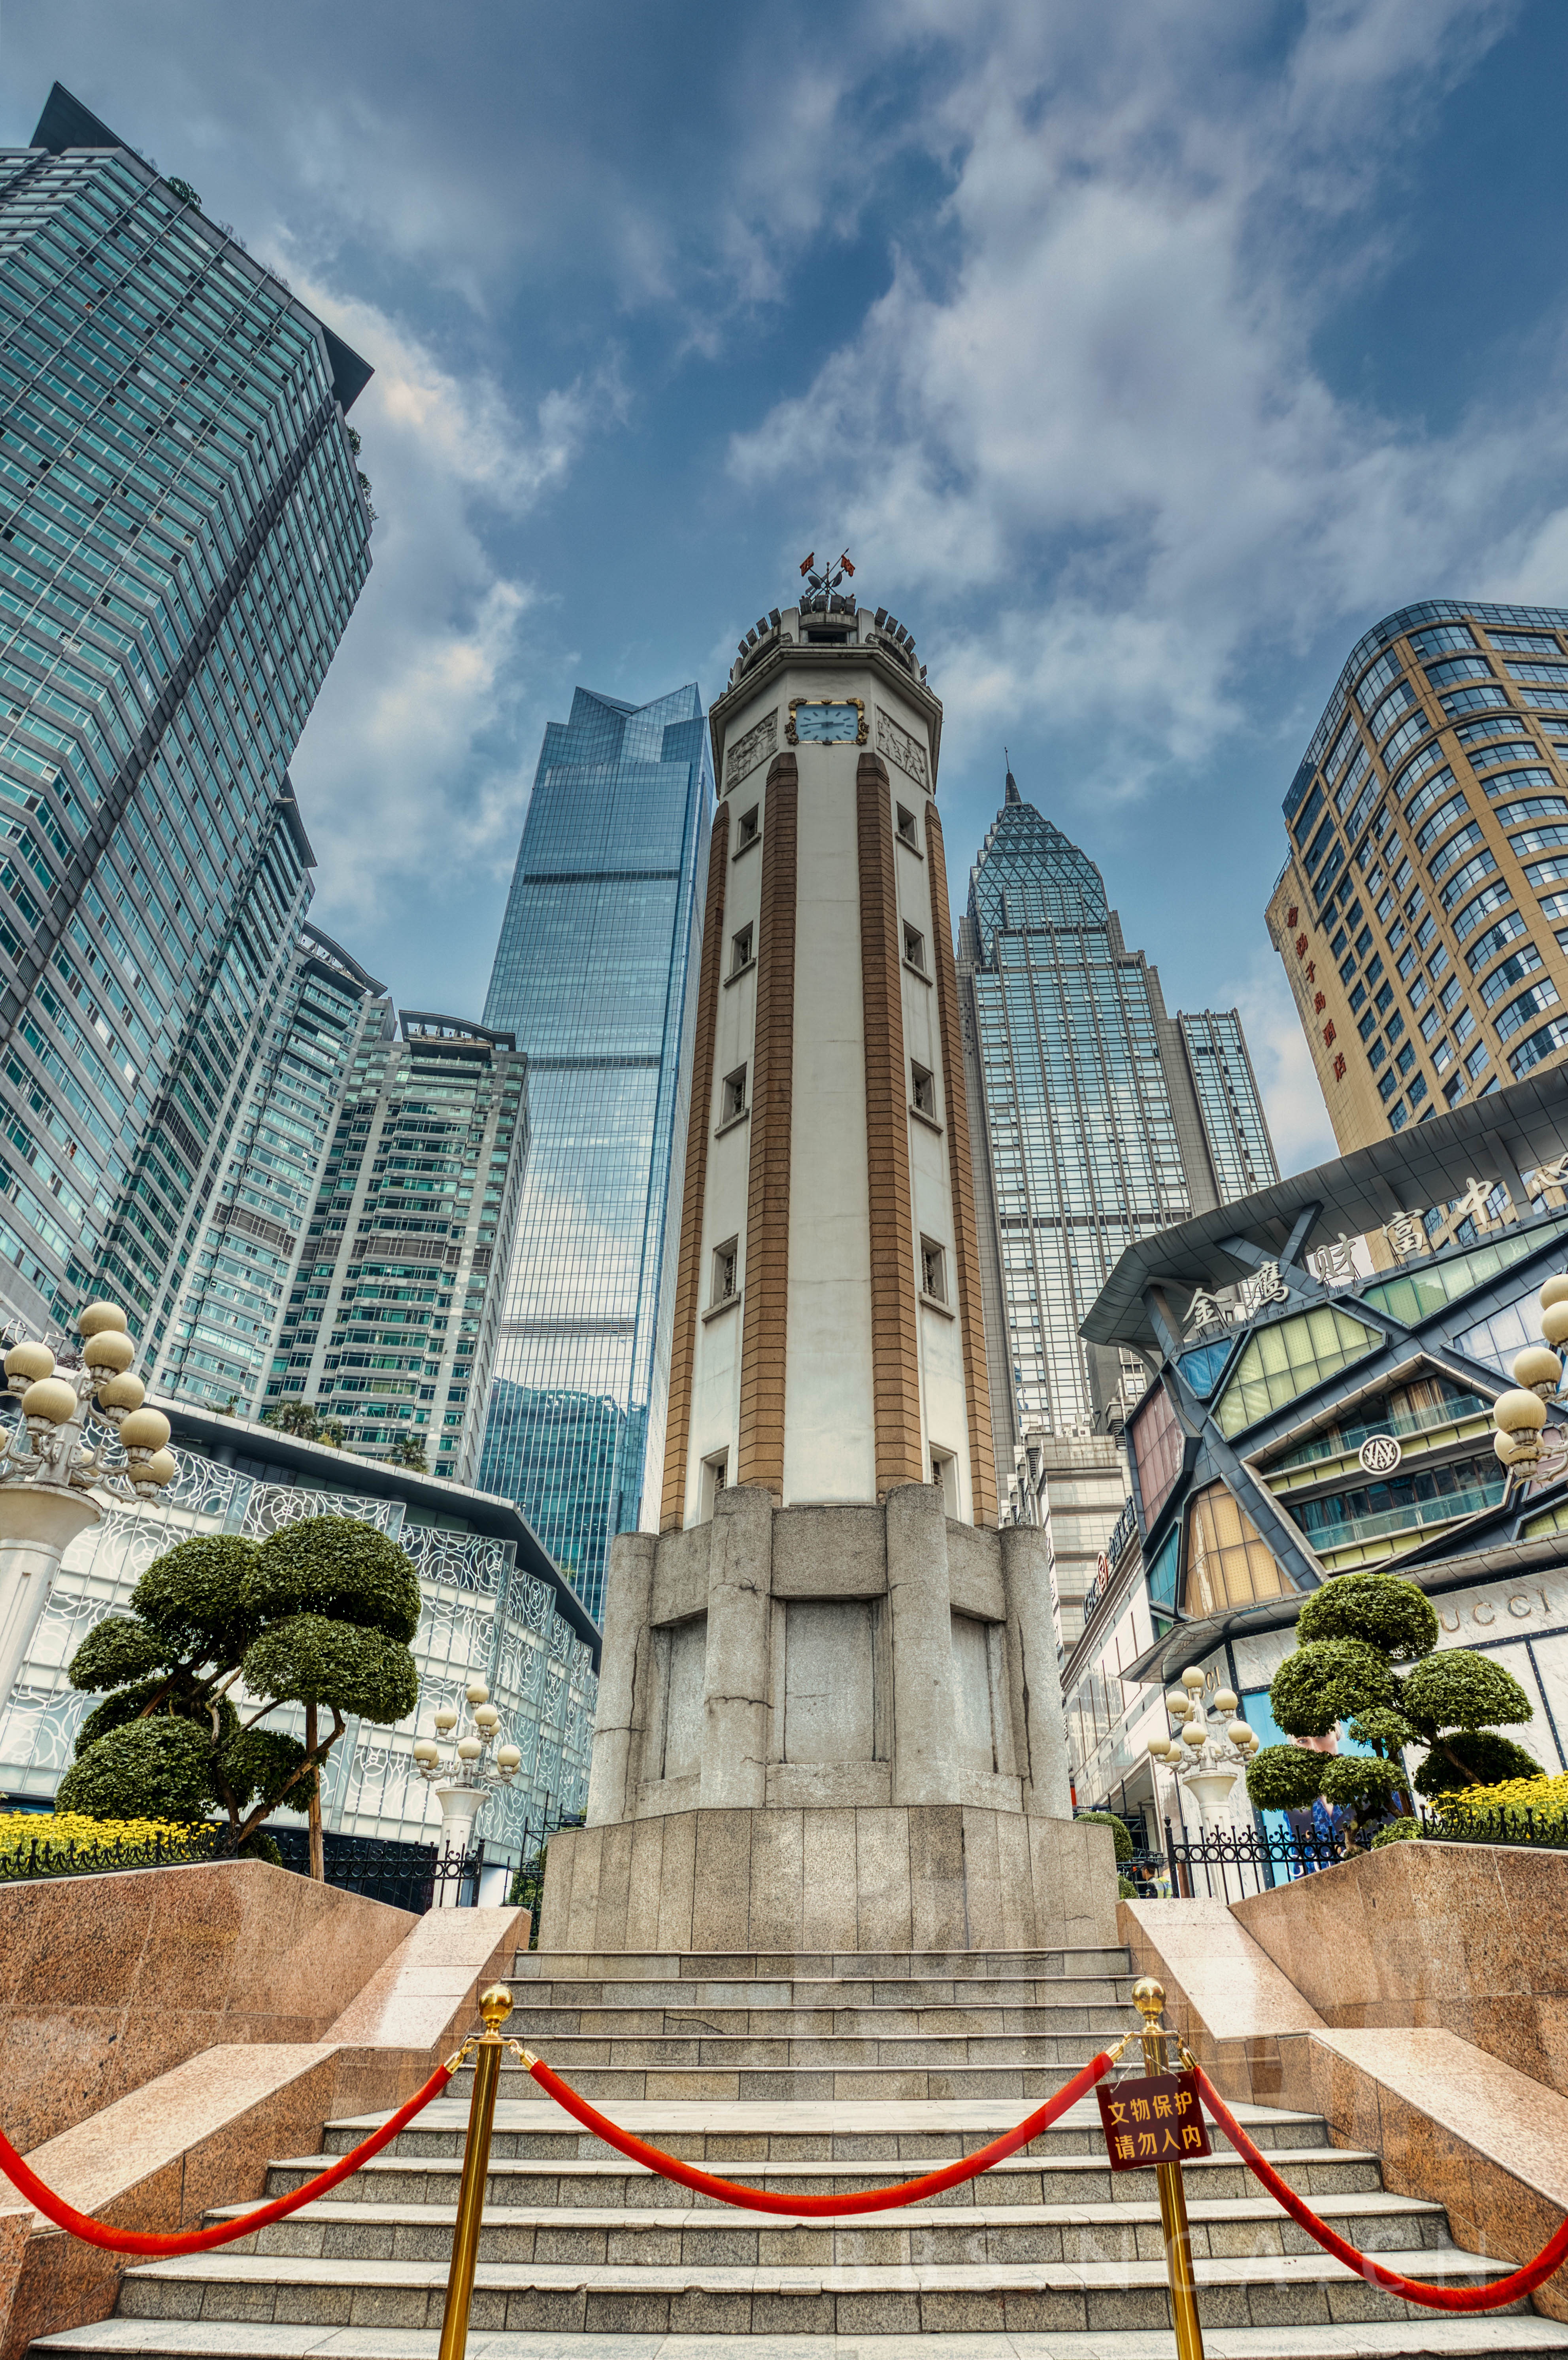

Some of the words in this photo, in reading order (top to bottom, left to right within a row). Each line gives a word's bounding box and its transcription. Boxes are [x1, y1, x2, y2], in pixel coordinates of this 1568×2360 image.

[1182, 1153, 1568, 1330] 金鹰财富中心
[1438, 1589, 1552, 1633] UCCI
[1108, 2091, 1193, 2126] 文物保护
